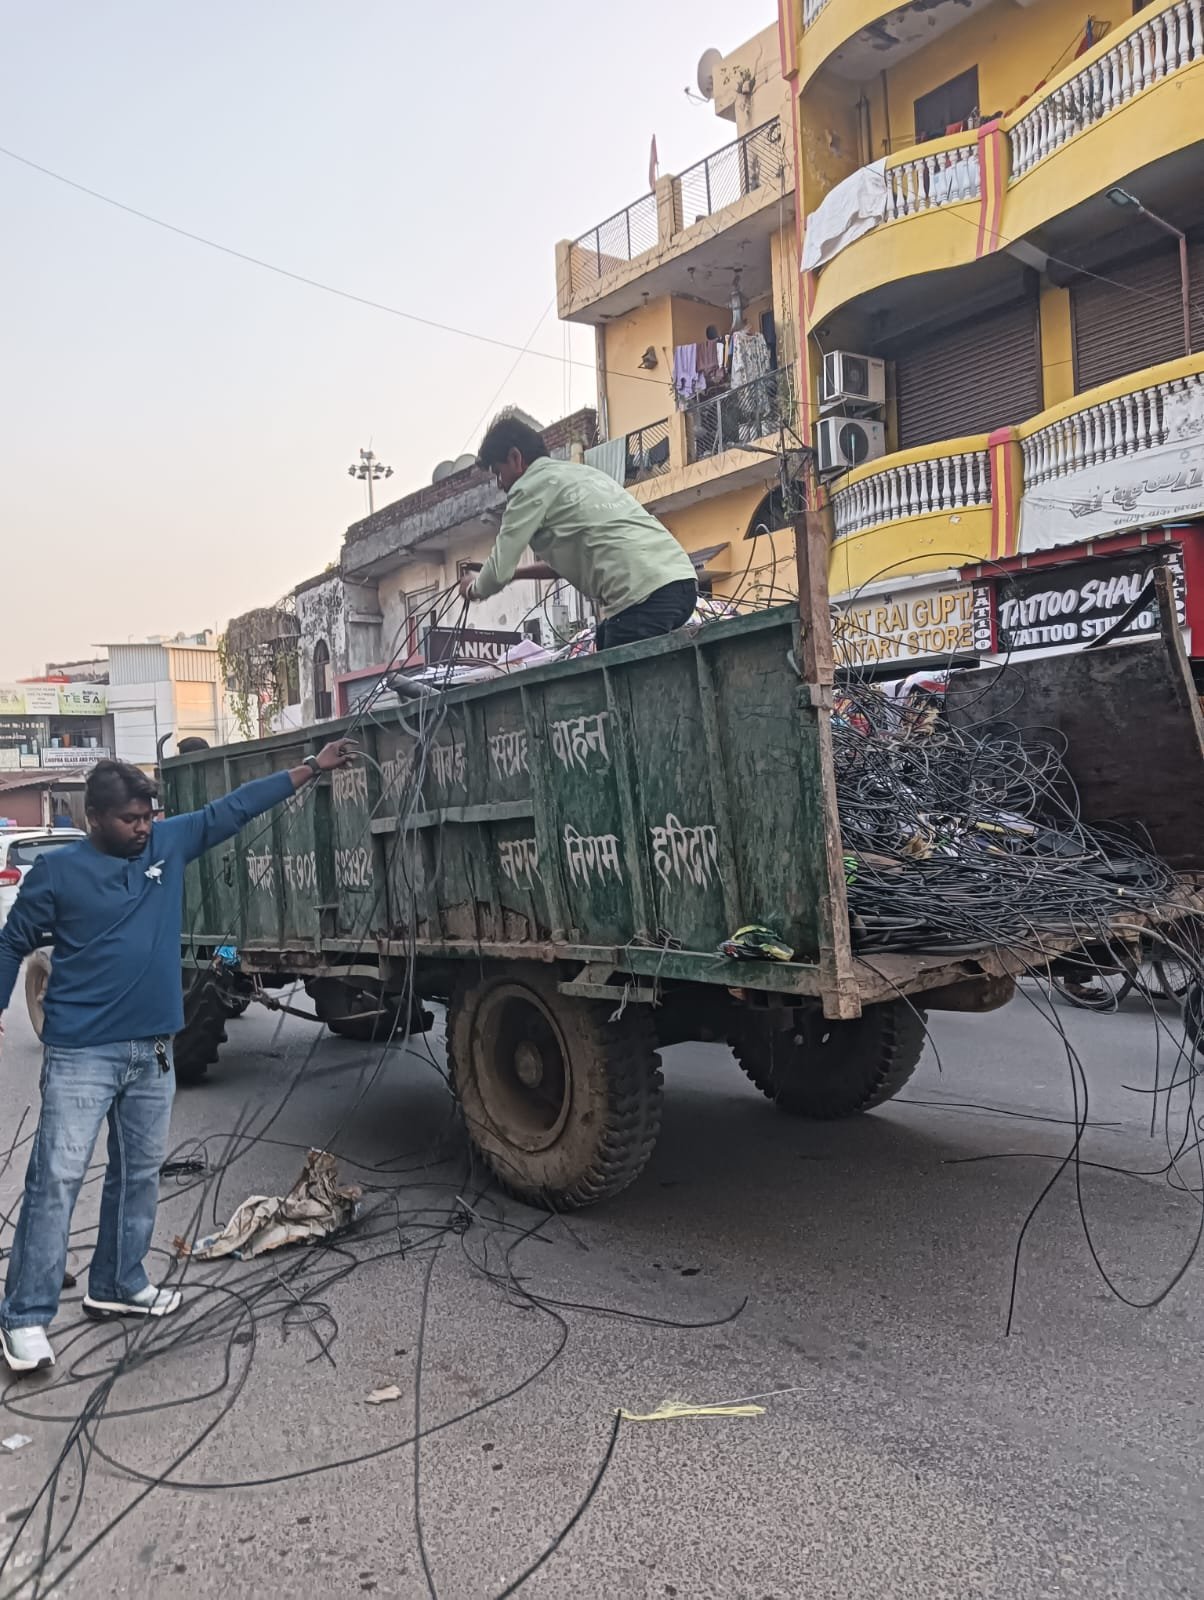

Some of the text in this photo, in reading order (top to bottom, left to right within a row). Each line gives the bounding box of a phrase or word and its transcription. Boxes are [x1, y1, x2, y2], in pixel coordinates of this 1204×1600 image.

[875, 602, 908, 633] RAI
[999, 567, 1154, 630] TATTOO SHAL
[453, 639, 511, 660] ANKU
[832, 622, 973, 665] ANITARY STORE
[1009, 610, 1153, 647] TATTOO STUIO
[550, 712, 610, 775] वाहन
[498, 813, 725, 893] नगर निगम हरिद्वार
